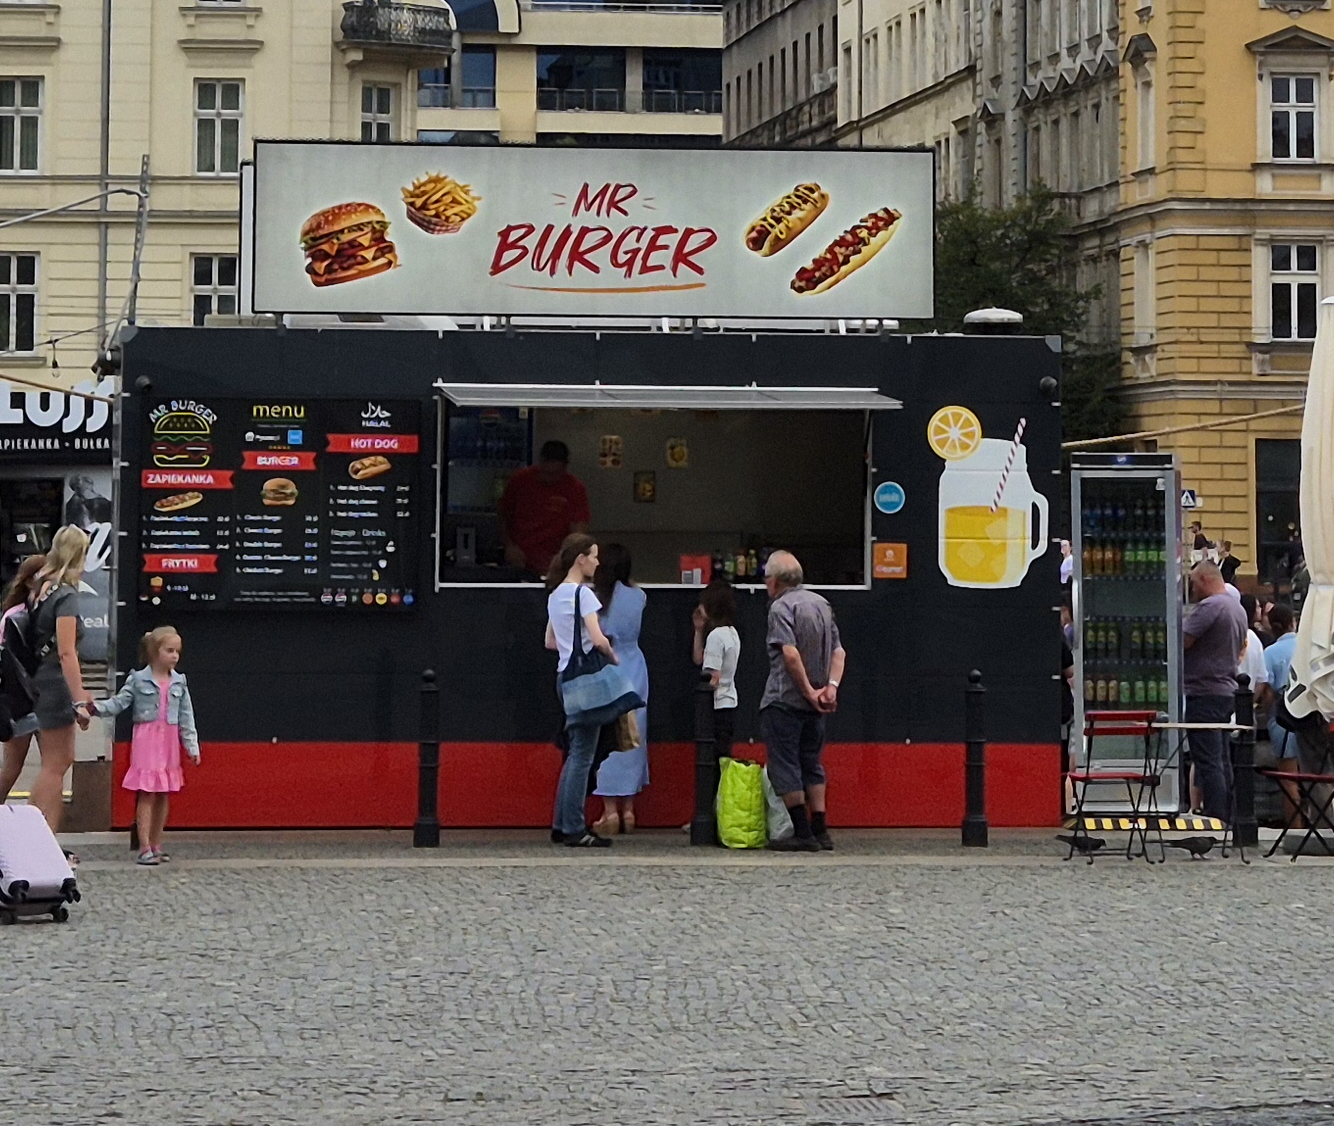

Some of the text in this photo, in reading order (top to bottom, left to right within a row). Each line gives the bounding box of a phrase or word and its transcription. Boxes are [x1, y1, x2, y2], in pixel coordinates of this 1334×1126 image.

[570, 182, 639, 219] MR
[488, 222, 719, 279] BURGER
[149, 399, 218, 426] MR BURGER
[252, 404, 305, 419] menu
[350, 438, 399, 449] HOT DOG
[256, 456, 300, 466] BURGER
[147, 473, 215, 485] ZAPIEKANKA
[161, 558, 199, 569] FRYTKI
